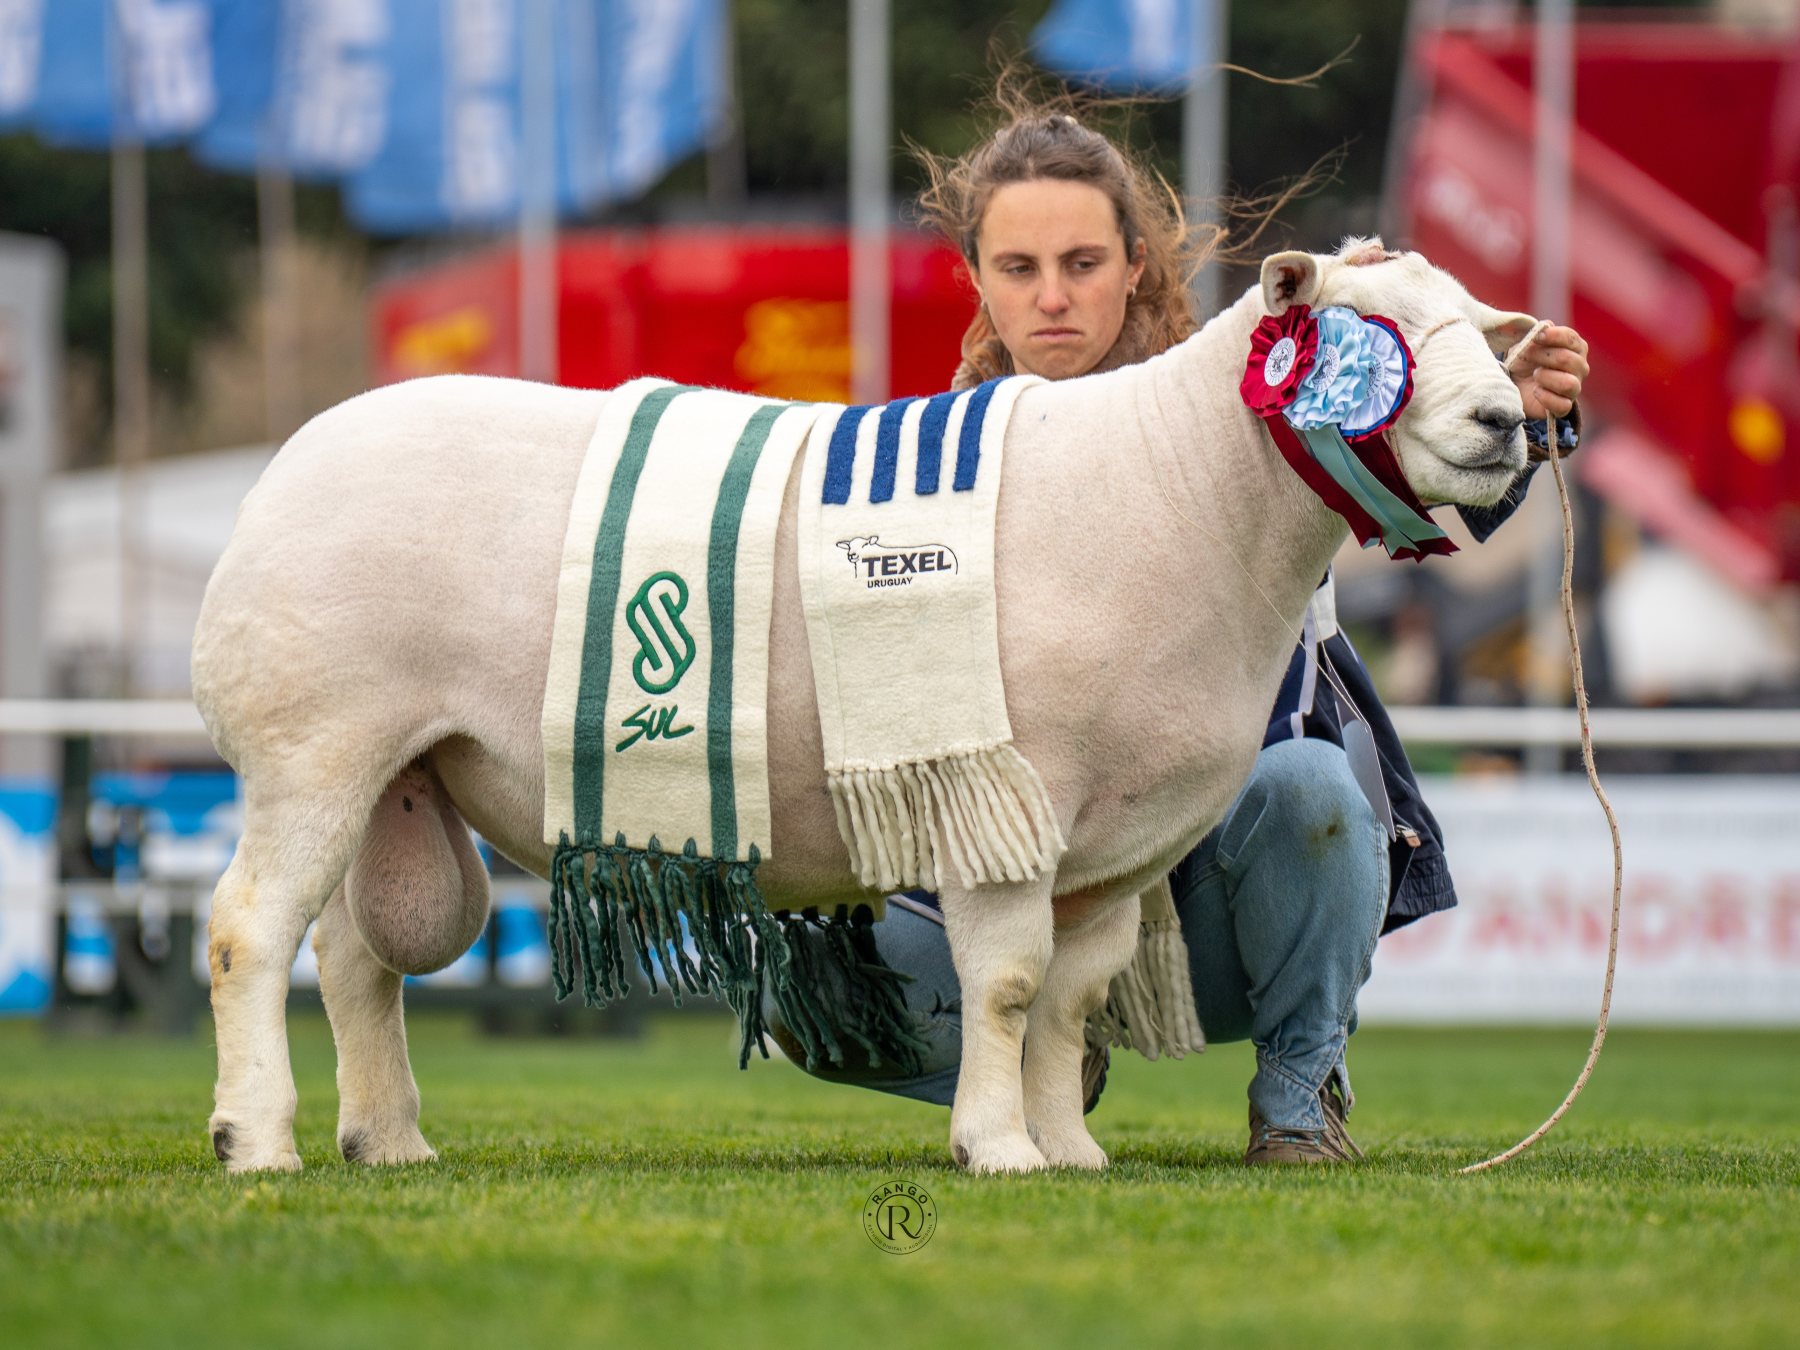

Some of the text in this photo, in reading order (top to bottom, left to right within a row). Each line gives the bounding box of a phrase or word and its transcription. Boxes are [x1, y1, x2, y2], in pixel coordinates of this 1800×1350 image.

[862, 551, 952, 578] TEXEL
[867, 577, 913, 588] URUGUAY
[615, 703, 695, 753] SUL
